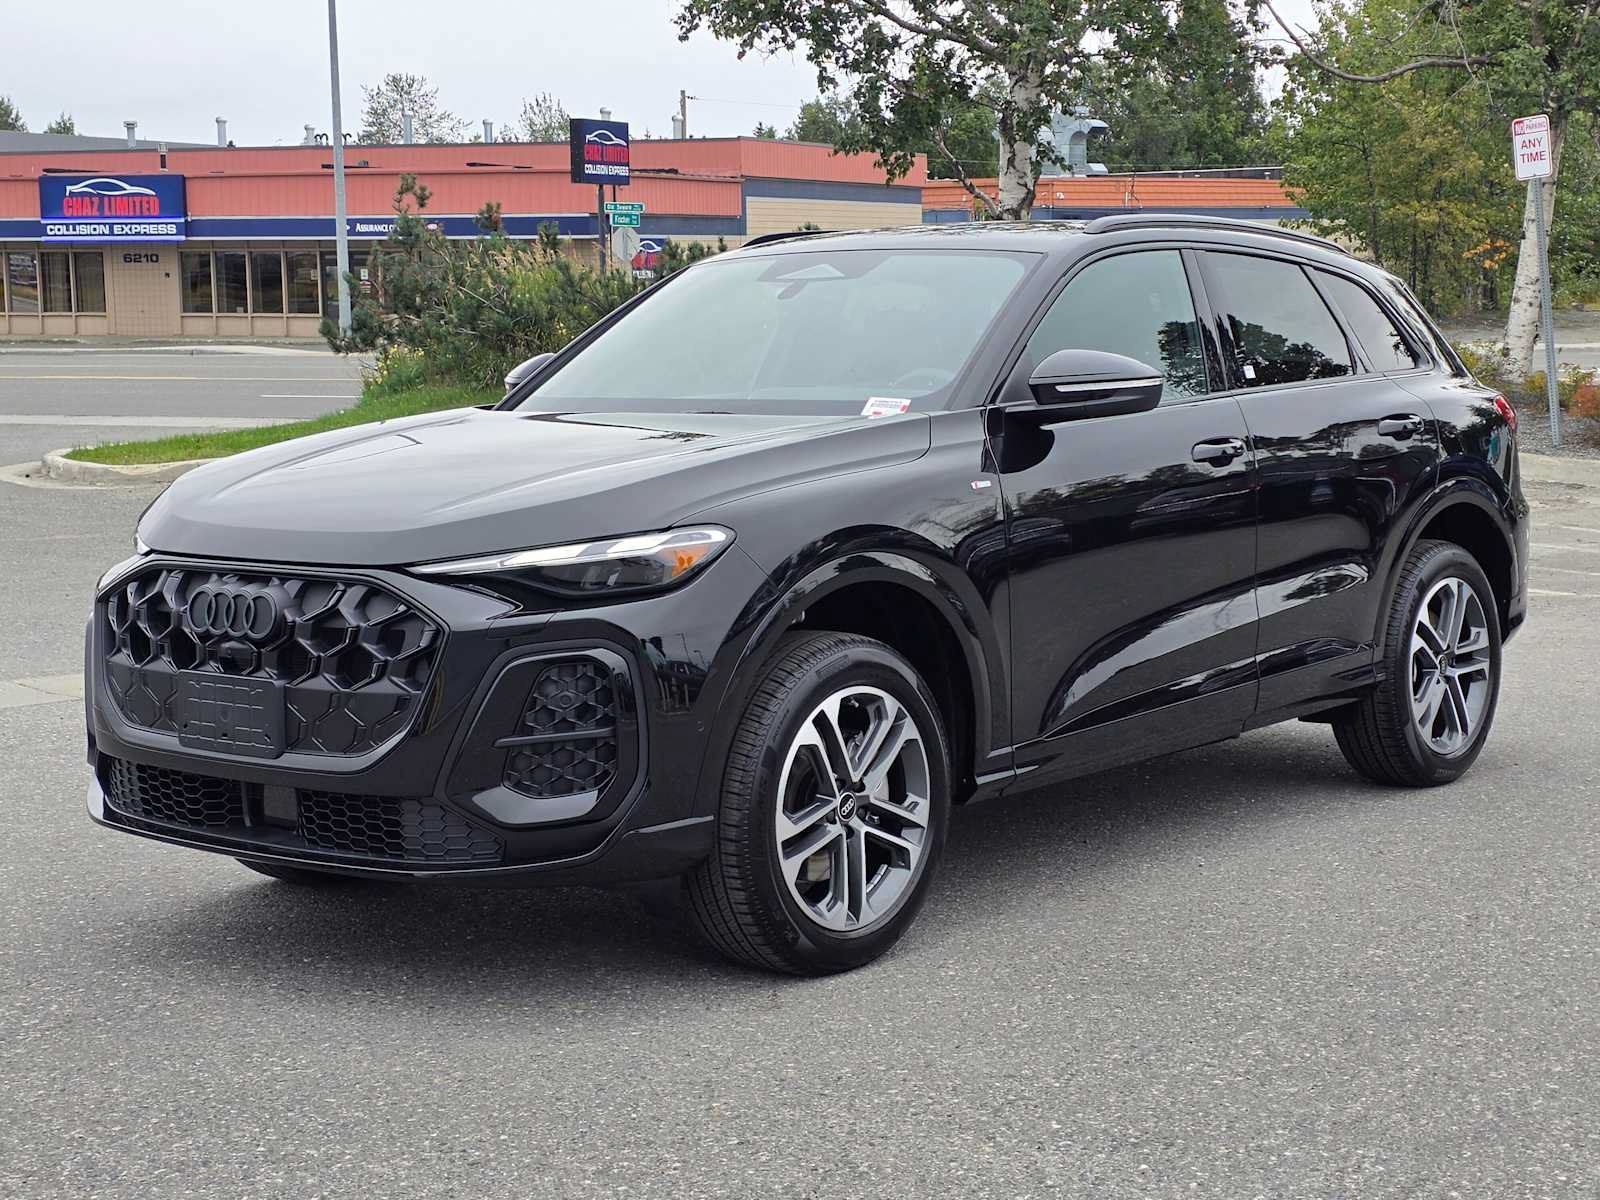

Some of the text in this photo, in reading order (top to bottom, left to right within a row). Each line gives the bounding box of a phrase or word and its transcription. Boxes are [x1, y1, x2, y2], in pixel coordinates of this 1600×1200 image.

[1521, 137, 1543, 150] ANY
[1520, 151, 1546, 164] TIME
[585, 164, 629, 176] COLLISION EXPRESS
[63, 196, 160, 216] CHAZ LIMITED
[47, 224, 177, 235] COLLISION EXPRESS
[123, 254, 159, 263] 6210
